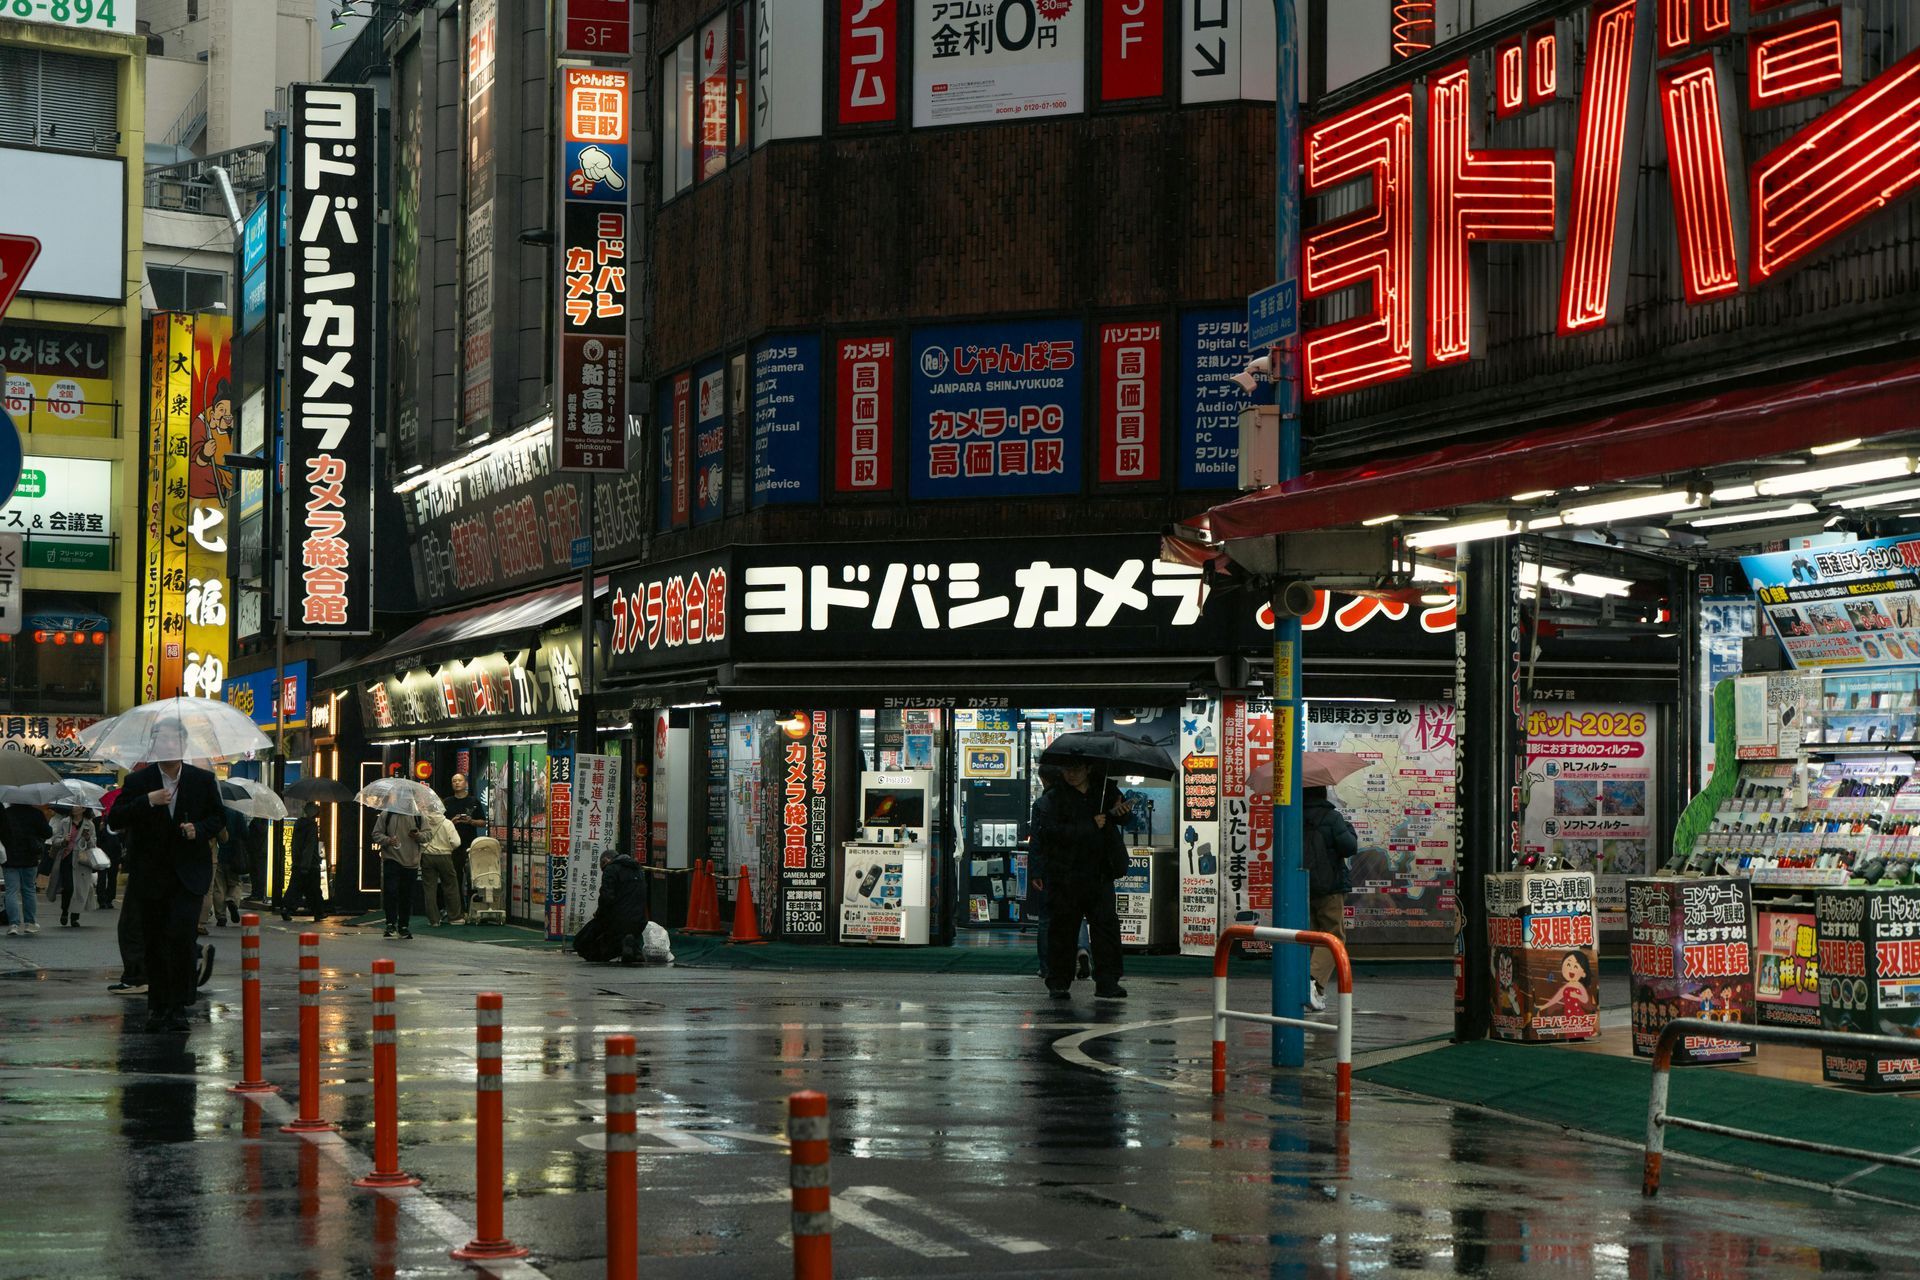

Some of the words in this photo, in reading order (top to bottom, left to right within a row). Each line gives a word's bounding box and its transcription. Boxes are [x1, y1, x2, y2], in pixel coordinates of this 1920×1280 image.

[0, 0, 116, 28] 8-894
[932, 1, 994, 21] アコムは
[584, 26, 612, 46] 3F
[569, 72, 626, 87] じゃんぱら
[577, 91, 618, 112] 高価
[1024, 101, 1067, 112] 0120-07-1000
[577, 116, 618, 136] 買取
[571, 174, 593, 194] 2F
[300, 90, 358, 450] ヨドバシカメラ
[595, 213, 625, 318] ヨドバシ
[566, 247, 593, 325] カメラ
[1103, 326, 1160, 344] パソコン!
[1197, 338, 1236, 350] Digital
[843, 341, 891, 361] カメラ!
[953, 340, 1076, 376] じゃんぱら
[930, 382, 982, 395] JANPARA
[986, 378, 1064, 392] SHINJYUKU02
[769, 393, 795, 404] Lens
[1116, 347, 1145, 476] 高価買取
[851, 362, 879, 487] 高価買取
[929, 404, 1064, 442] カメラ・PC
[1195, 433, 1212, 444] PC
[929, 438, 1064, 480] 高価買取
[1195, 446, 1239, 460] タブレッ
[1195, 462, 1236, 474] Mobile
[32, 514, 43, 529] &
[50, 511, 104, 532] 会議室
[302, 454, 348, 625] カメラ総合館
[184, 507, 227, 699] 七福神
[744, 560, 1211, 633] ヨドバシカメラ
[611, 566, 727, 655] カメラ総合館
[884, 697, 956, 708] ヨドバシカメラ
[0, 717, 49, 739] 貝類
[811, 710, 827, 794] ヨドバシカメラ
[1187, 756, 1216, 768] こちらです
[1563, 762, 1617, 772] PLフィルター
[783, 741, 808, 869] カメラ総合館
[551, 783, 572, 856] 高額買取
[1563, 820, 1630, 830] ソフトフィルター
[811, 797, 826, 869] 新宿西口本店
[783, 871, 808, 879] CAMERA
[809, 871, 826, 879] SHOP
[786, 890, 822, 901] 営業時間
[1528, 878, 1591, 901] 舞台・観劇
[1683, 884, 1743, 905] コンサート
[1531, 900, 1591, 914] におすすめ!
[1684, 903, 1745, 926] スポーツ観戦
[792, 922, 822, 932] 10:00
[1530, 915, 1593, 948] 双眼鏡
[1684, 926, 1746, 942] におすすめ!
[1631, 944, 1674, 978] 双眼鏡
[1683, 942, 1749, 979] 双眼鏡
[1818, 940, 1866, 976] 双眼鏡
[1531, 1013, 1597, 1029] ヨドバシカメラ
